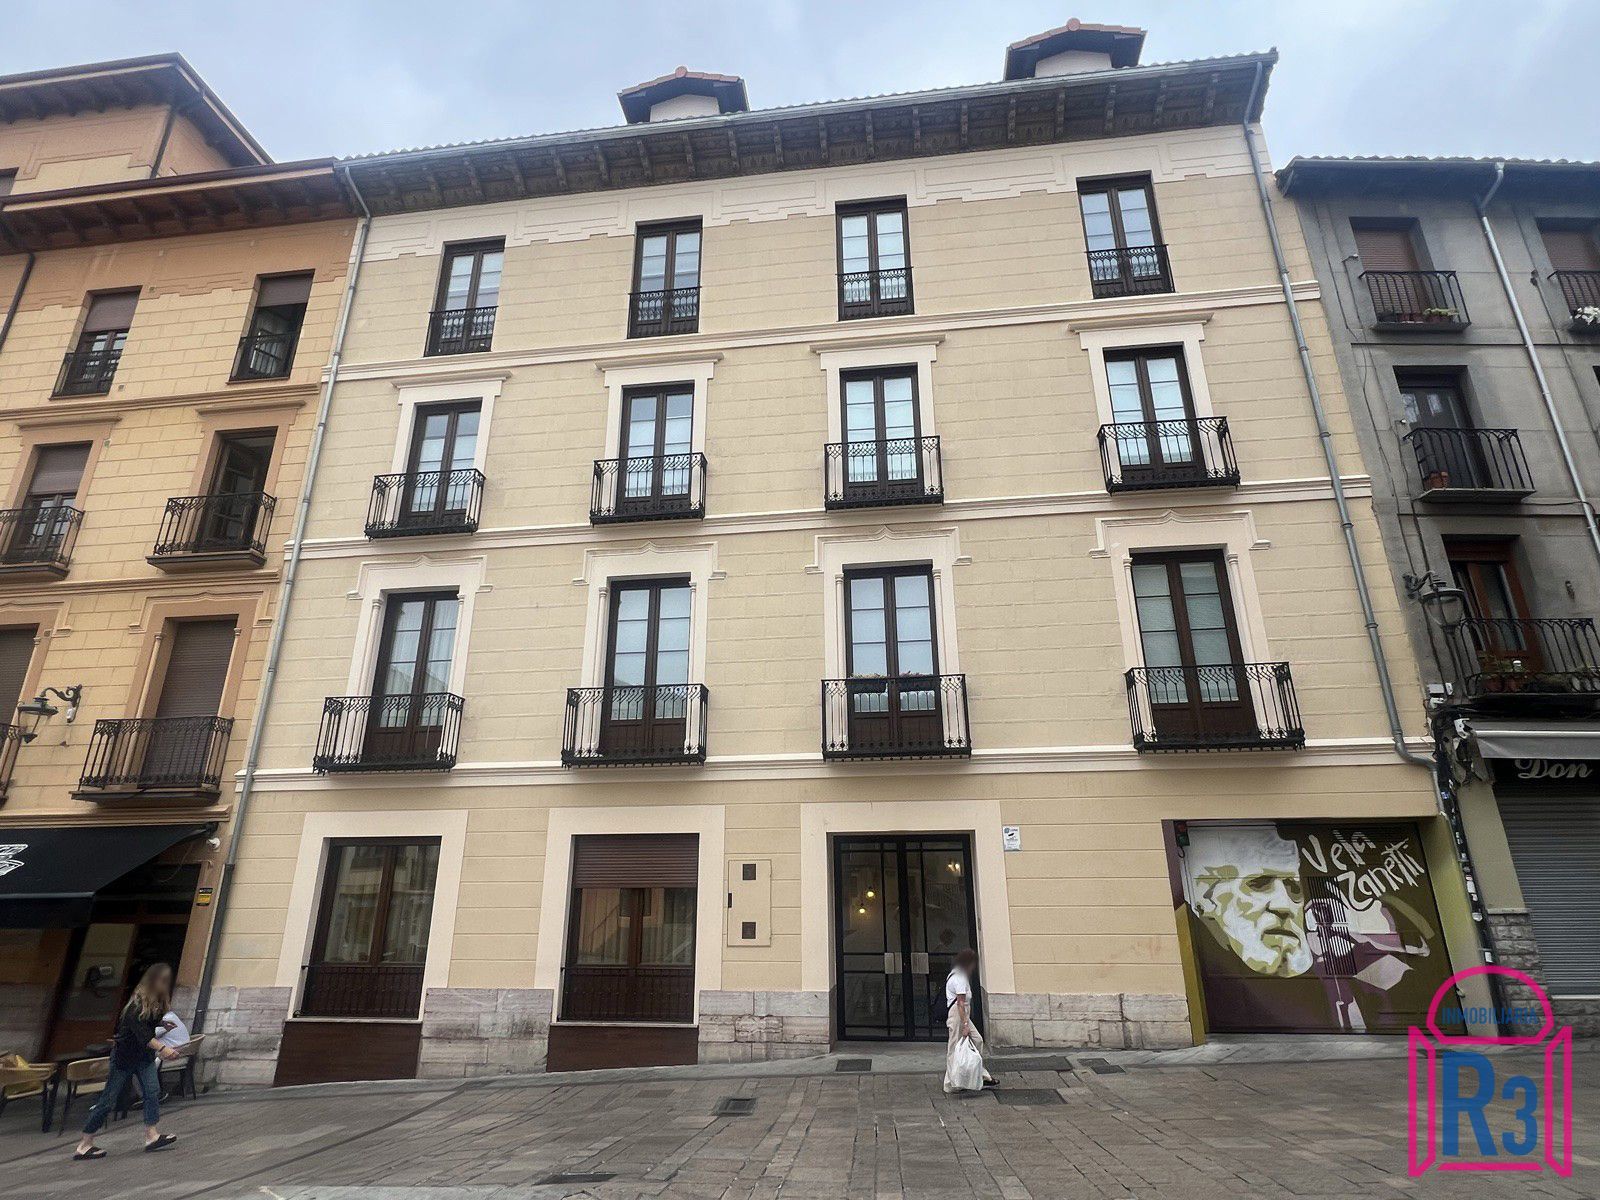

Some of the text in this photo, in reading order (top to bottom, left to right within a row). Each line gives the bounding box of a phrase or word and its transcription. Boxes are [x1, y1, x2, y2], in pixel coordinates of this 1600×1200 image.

[1514, 759, 1593, 778] Don
[1302, 829, 1376, 873] Vela
[1337, 838, 1425, 910] Zanetti
